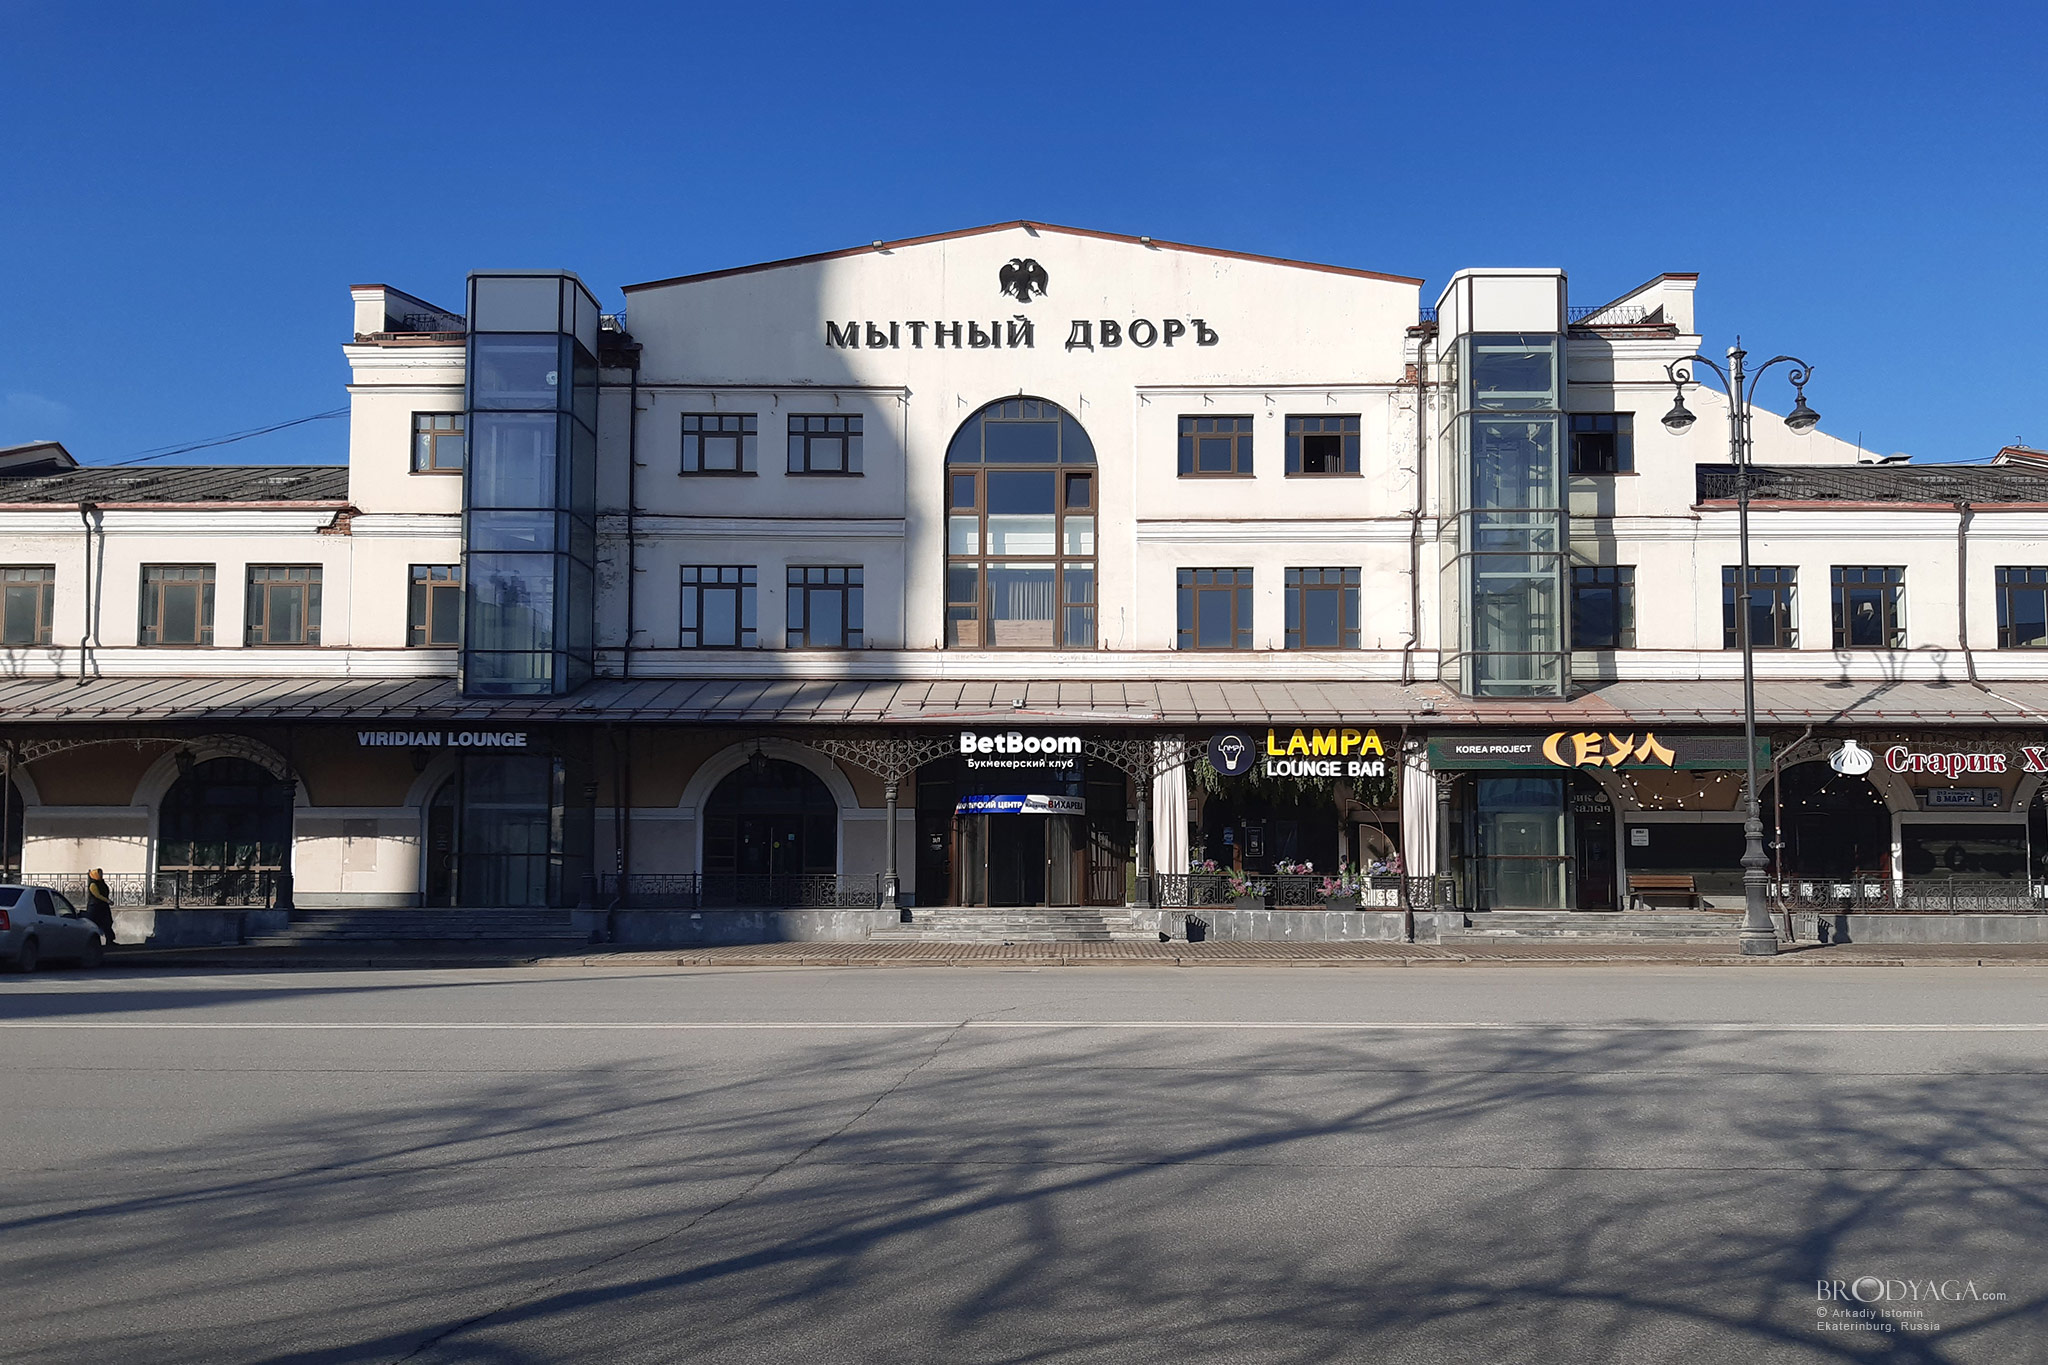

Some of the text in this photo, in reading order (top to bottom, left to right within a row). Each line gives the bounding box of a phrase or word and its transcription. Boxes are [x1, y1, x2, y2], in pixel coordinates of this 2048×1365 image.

[826, 314, 1219, 352] МЫТНЫЙ ДВОРЪ
[357, 732, 527, 746] VIRIDIAN LOUNGE
[960, 732, 1082, 754] BetBoom
[1267, 728, 1385, 756] LAMPA
[1455, 744, 1532, 754] KOREA PROJECT
[1542, 731, 1676, 767] СЕУЛ
[967, 758, 1075, 770] Букмекерский клуб
[1266, 760, 1385, 777] LOUNGE BAR
[1885, 745, 2048, 779] Старик Х
[998, 801, 1023, 810] ЦЕНТР
